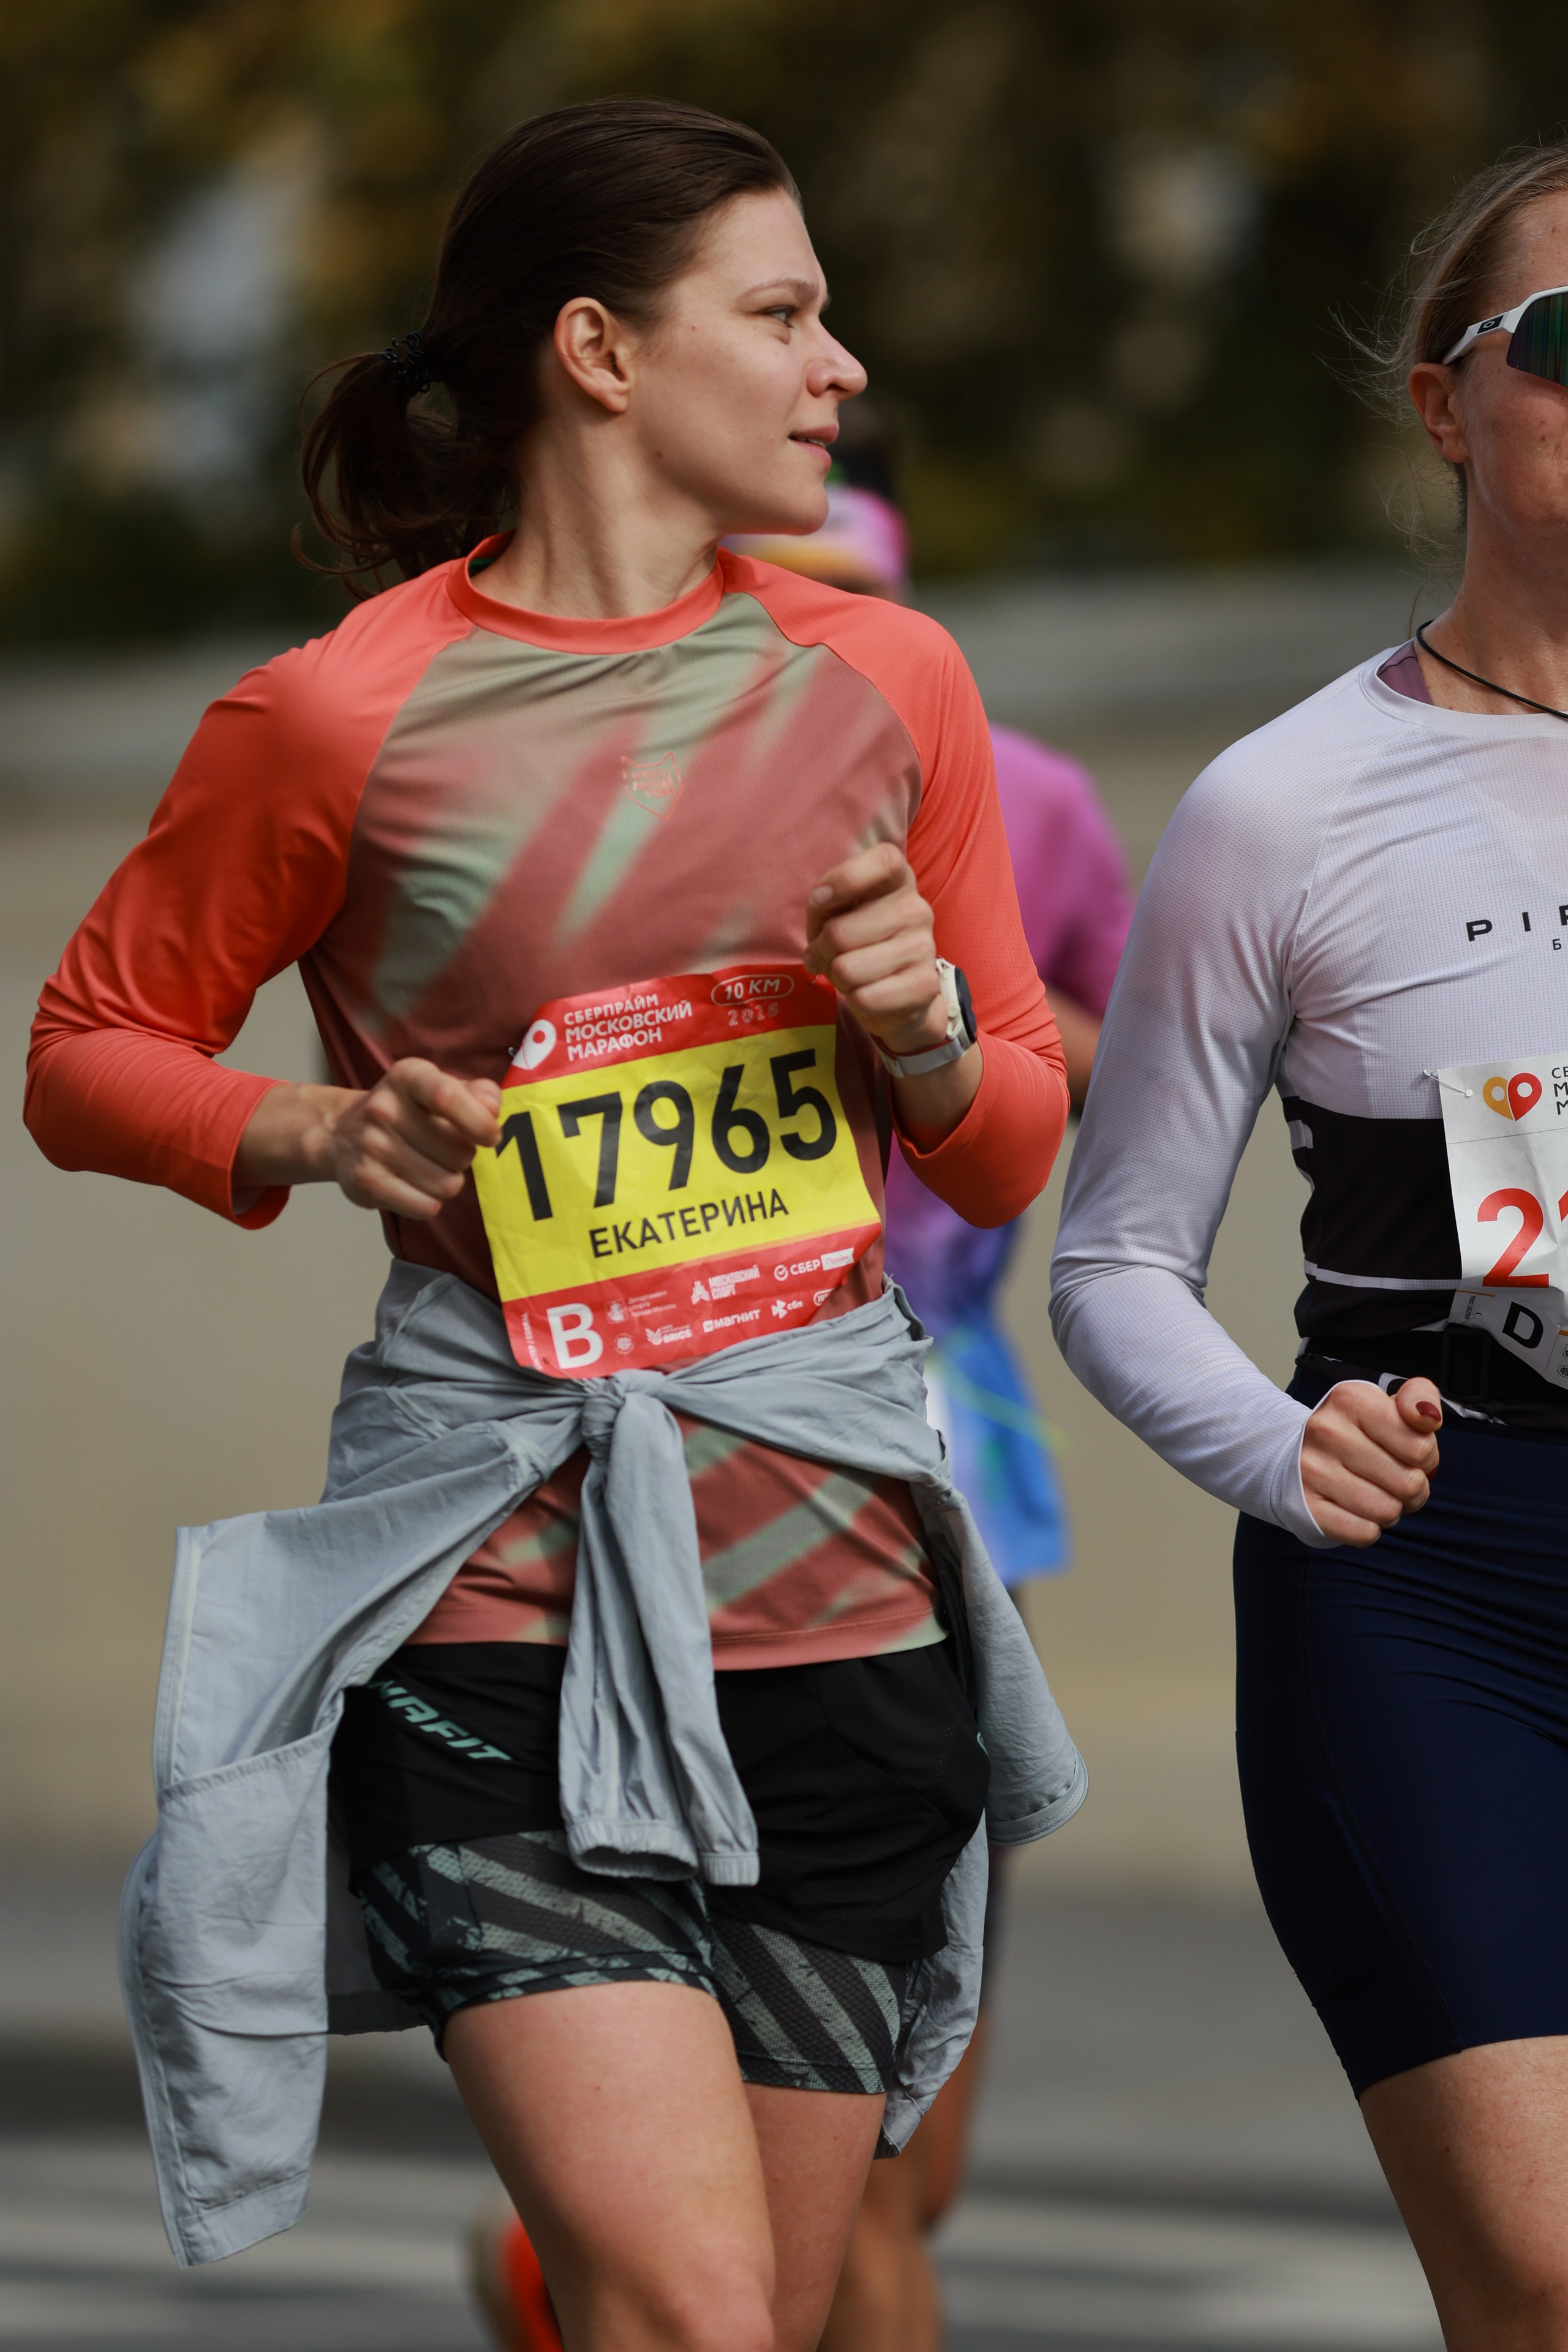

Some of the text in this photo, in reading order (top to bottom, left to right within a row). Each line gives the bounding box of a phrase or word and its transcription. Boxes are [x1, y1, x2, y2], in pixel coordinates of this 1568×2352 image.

[725, 982, 744, 1000] 10
[564, 993, 659, 1026] СБЕРПРАЙМ
[565, 999, 693, 1044] МОСКОВСКИЙ
[567, 1027, 663, 1061] МАРАФОН
[495, 1049, 837, 1222] 17965
[589, 1188, 789, 1258] ЕКАТЕРИНА
[790, 1259, 821, 1276] СБЕР
[710, 1284, 736, 1300] СПОРТ
[1502, 1301, 1544, 1349] D
